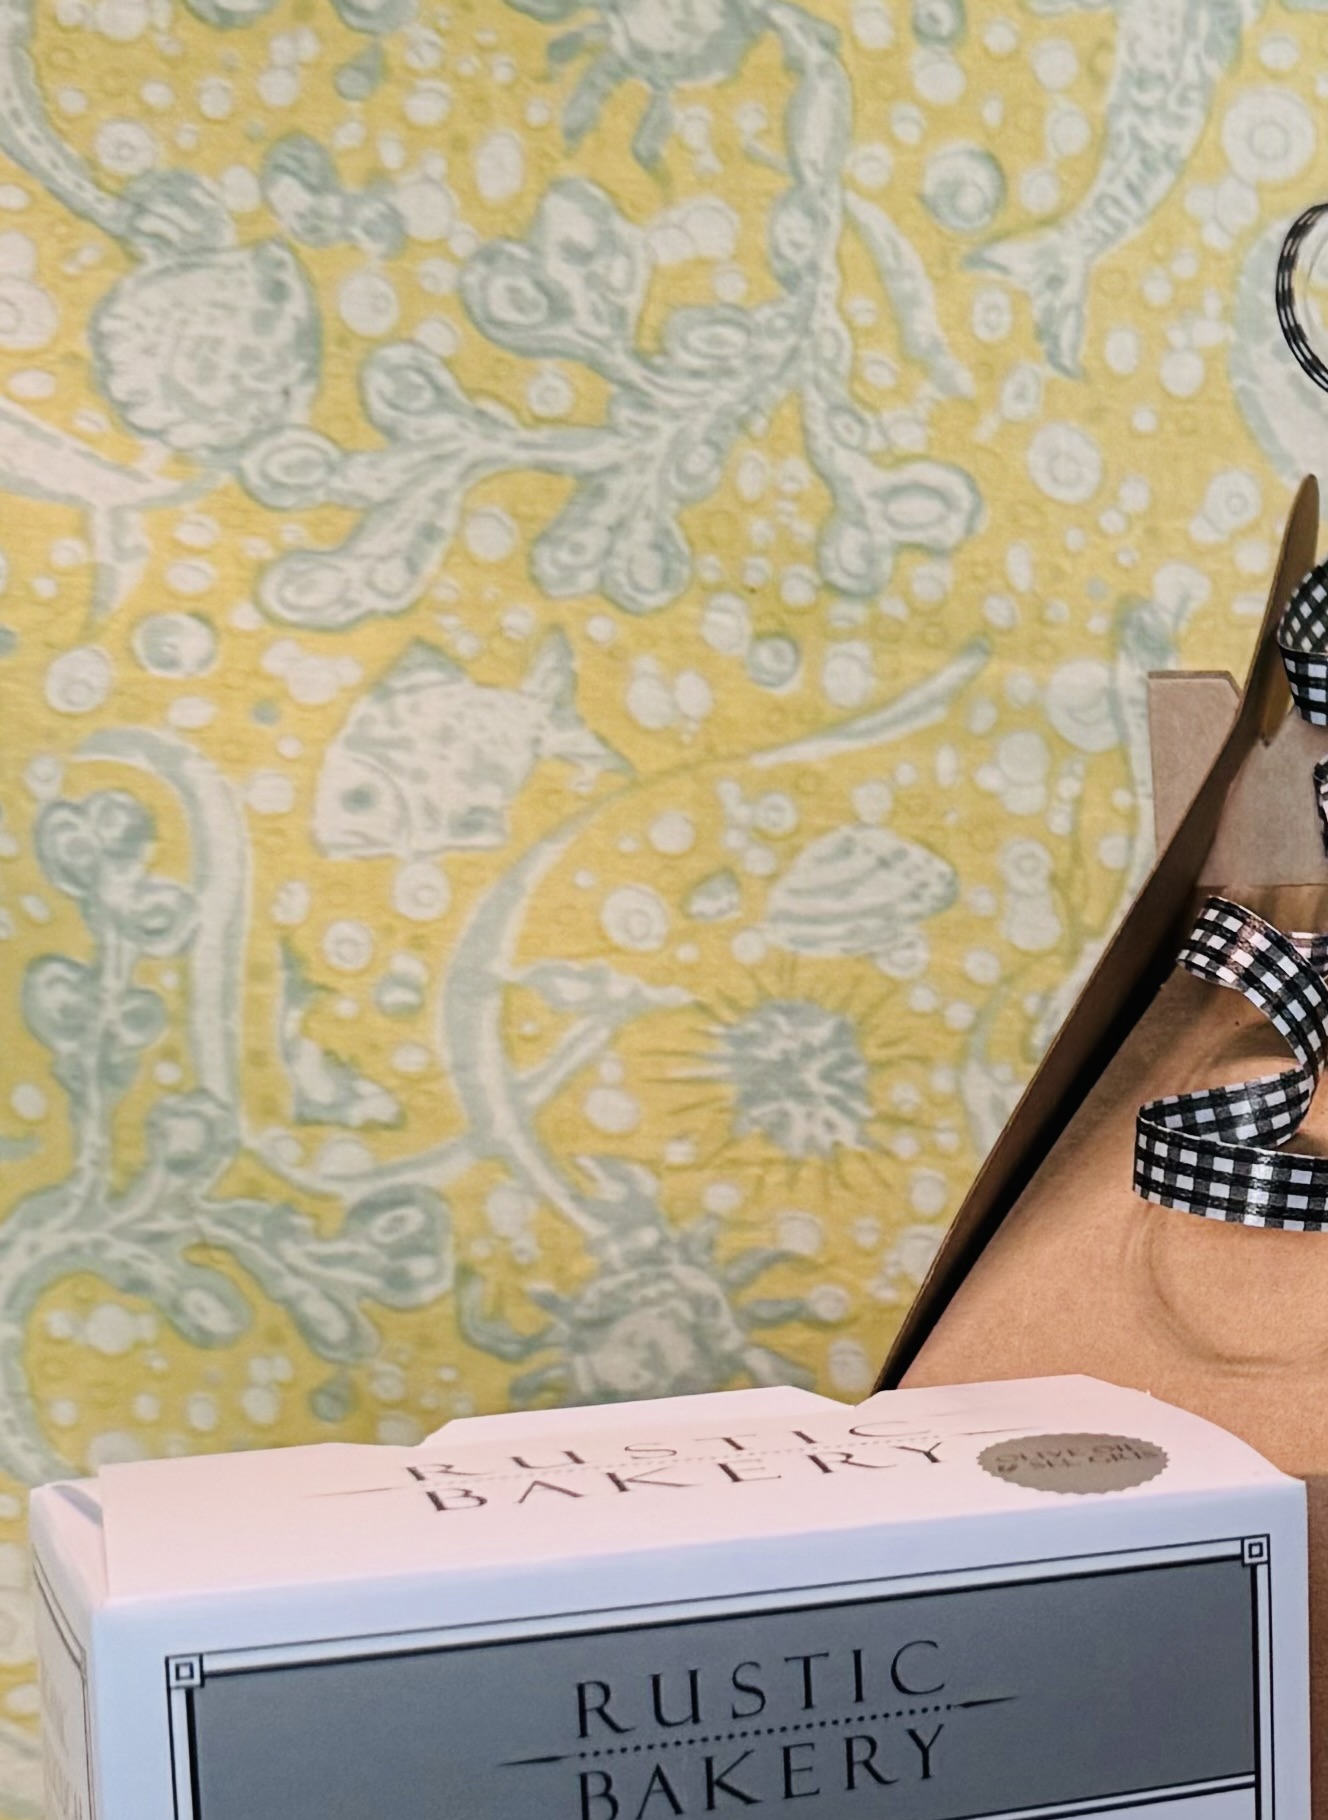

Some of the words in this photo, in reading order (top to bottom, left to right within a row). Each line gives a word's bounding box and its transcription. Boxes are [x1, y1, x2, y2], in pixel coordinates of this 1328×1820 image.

[405, 1421, 931, 1482] RUSTIC
[425, 1440, 946, 1513] BAKERY
[576, 1640, 945, 1738] RUSTIC
